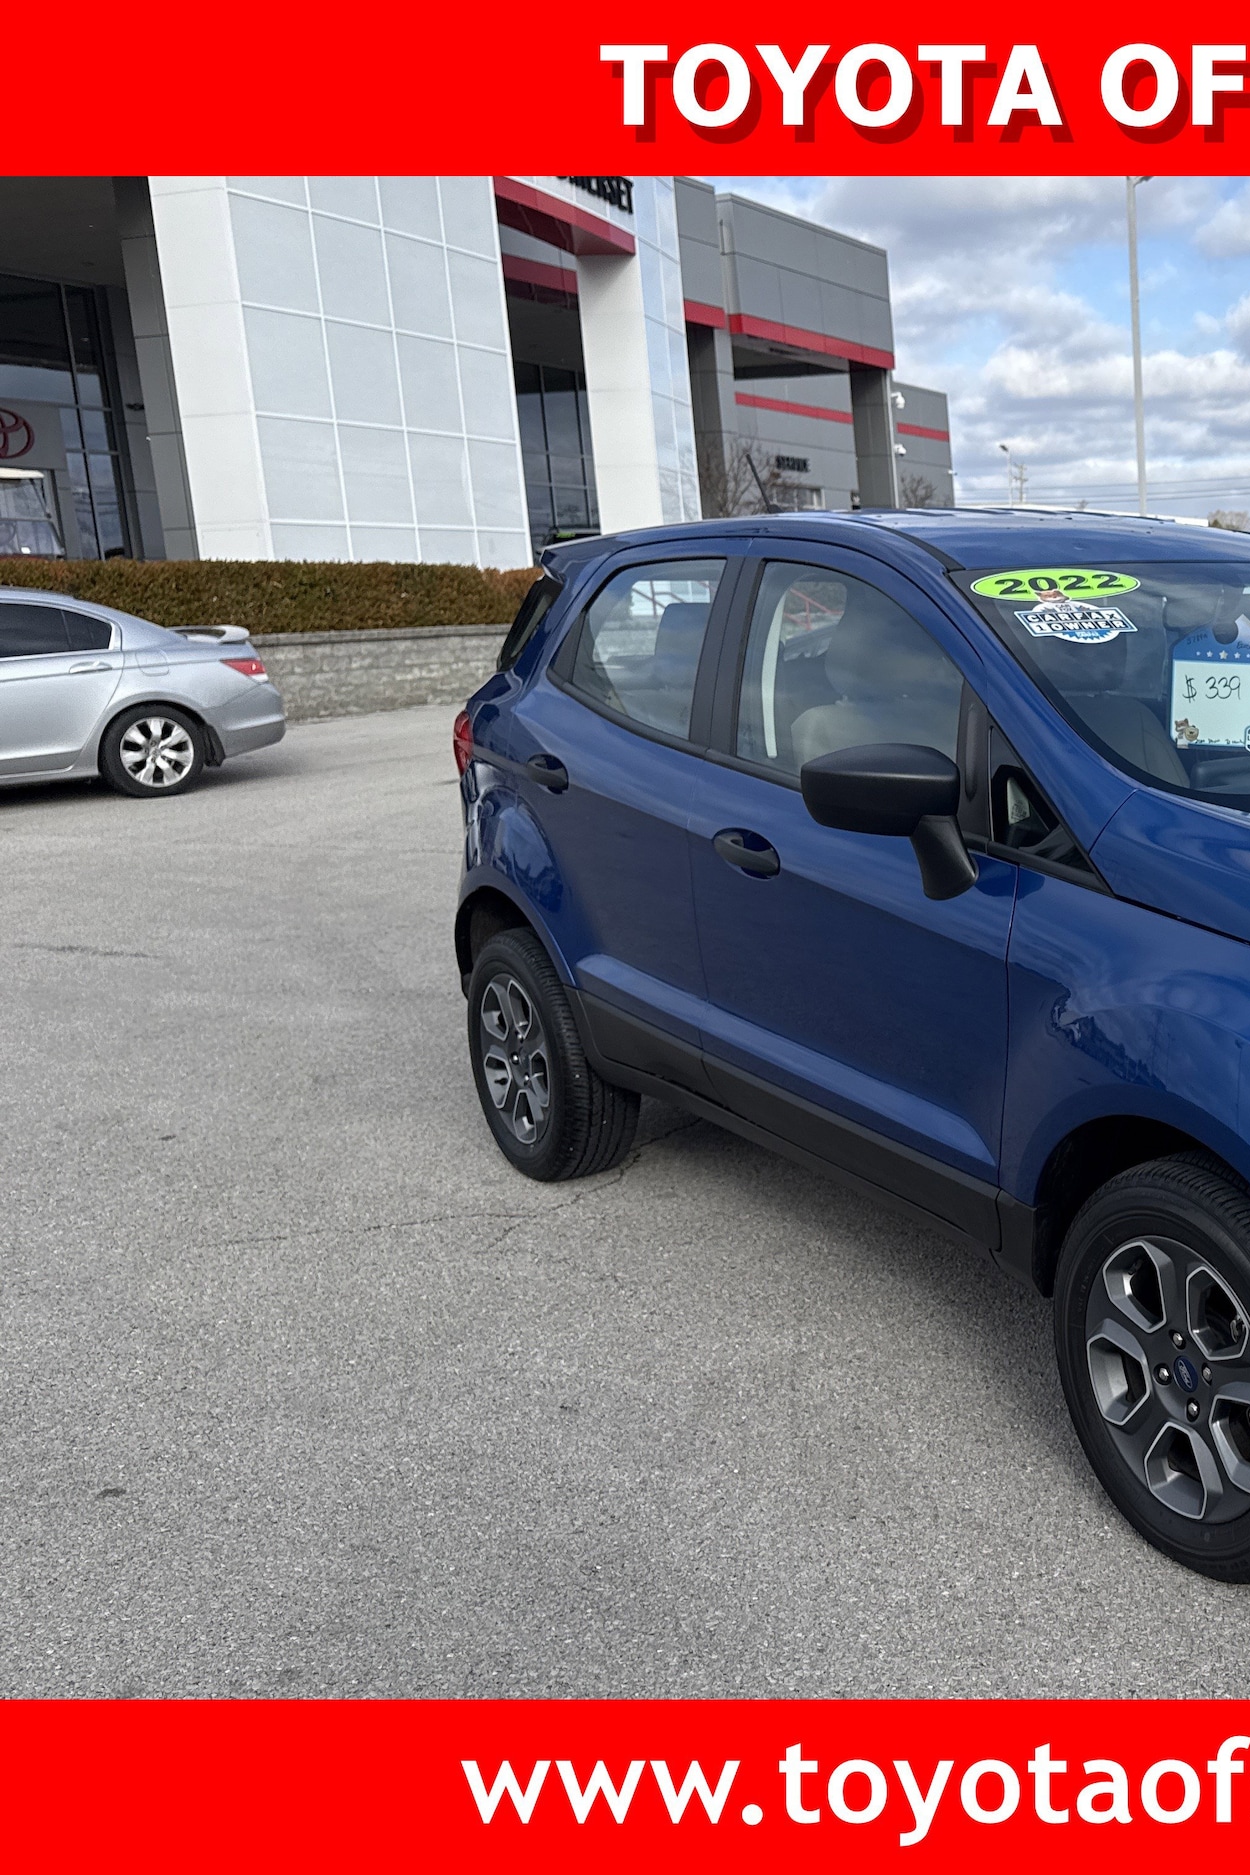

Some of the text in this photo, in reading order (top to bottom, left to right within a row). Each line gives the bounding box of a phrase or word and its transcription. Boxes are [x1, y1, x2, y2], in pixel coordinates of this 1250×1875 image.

[995, 574, 1126, 595] 2022
[1026, 611, 1118, 622] CARFAX
[1205, 675, 1241, 700] 339
